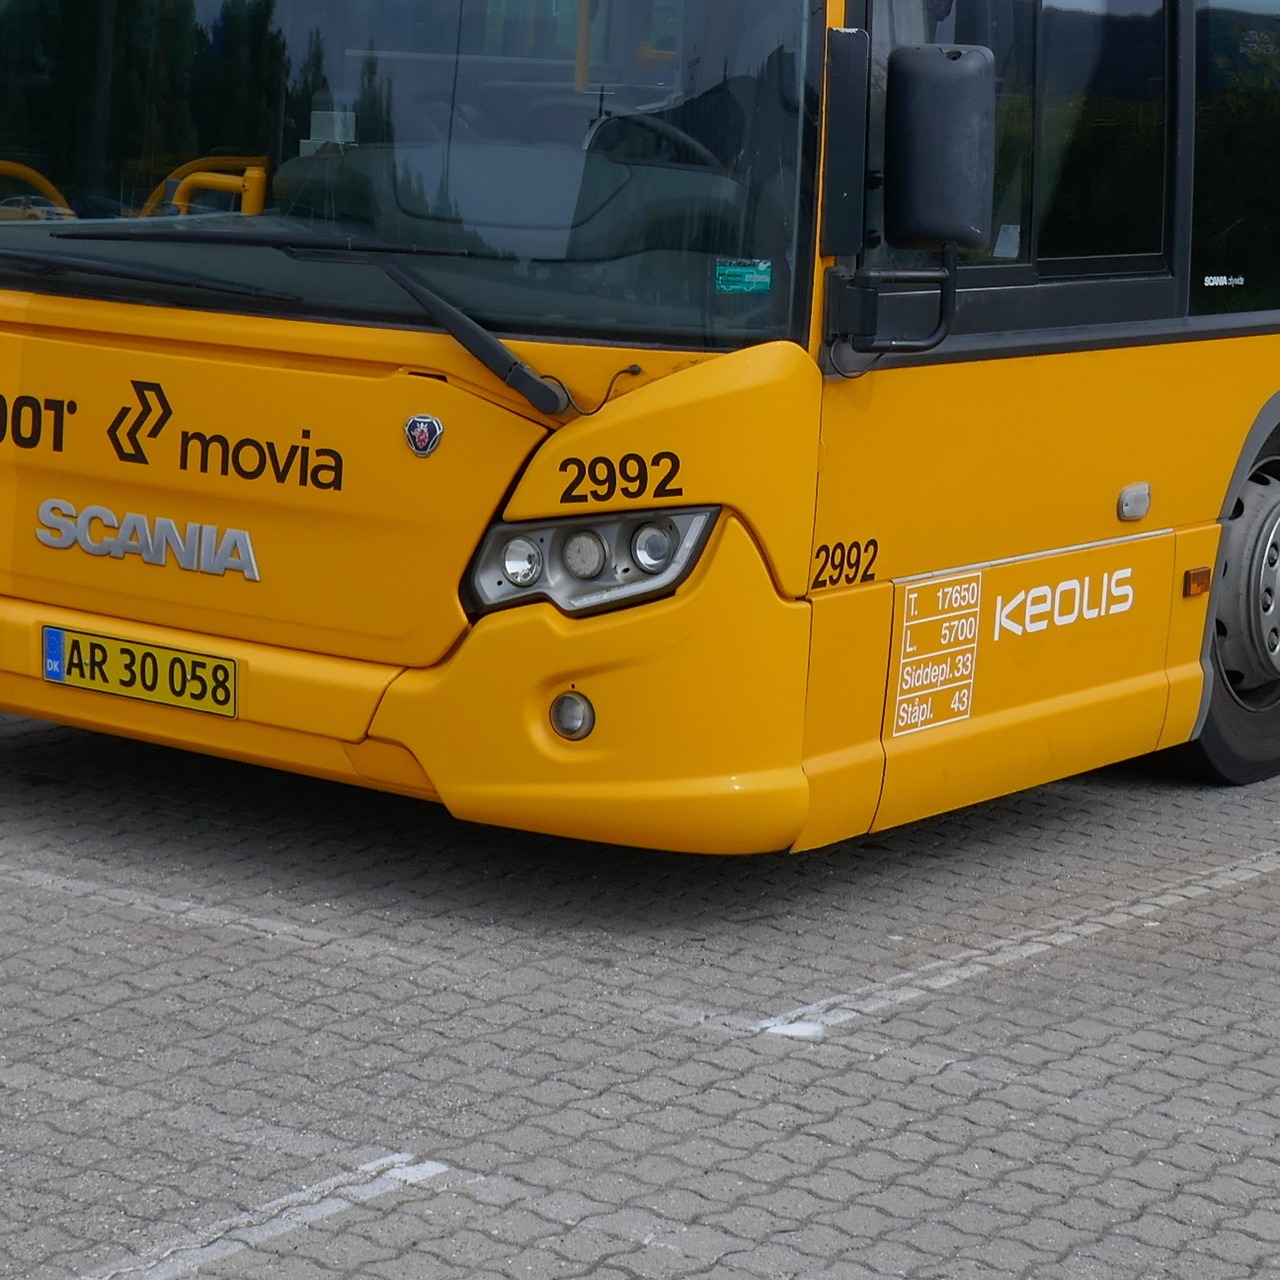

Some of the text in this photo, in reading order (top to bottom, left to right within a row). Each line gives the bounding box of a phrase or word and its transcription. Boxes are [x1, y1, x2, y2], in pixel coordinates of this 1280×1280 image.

[1204, 276, 1227, 286] SCANIA
[179, 429, 344, 491] movia
[558, 451, 683, 504] 2992
[35, 497, 261, 582] SCANIA
[811, 538, 879, 590] 2992
[909, 582, 978, 616] T. 17650
[905, 616, 975, 652] L. 5700
[46, 658, 60, 672] DK
[66, 639, 231, 706] AR 30 058
[902, 653, 972, 690] Siddepl. 33
[897, 688, 969, 727] Ståpl. 43
